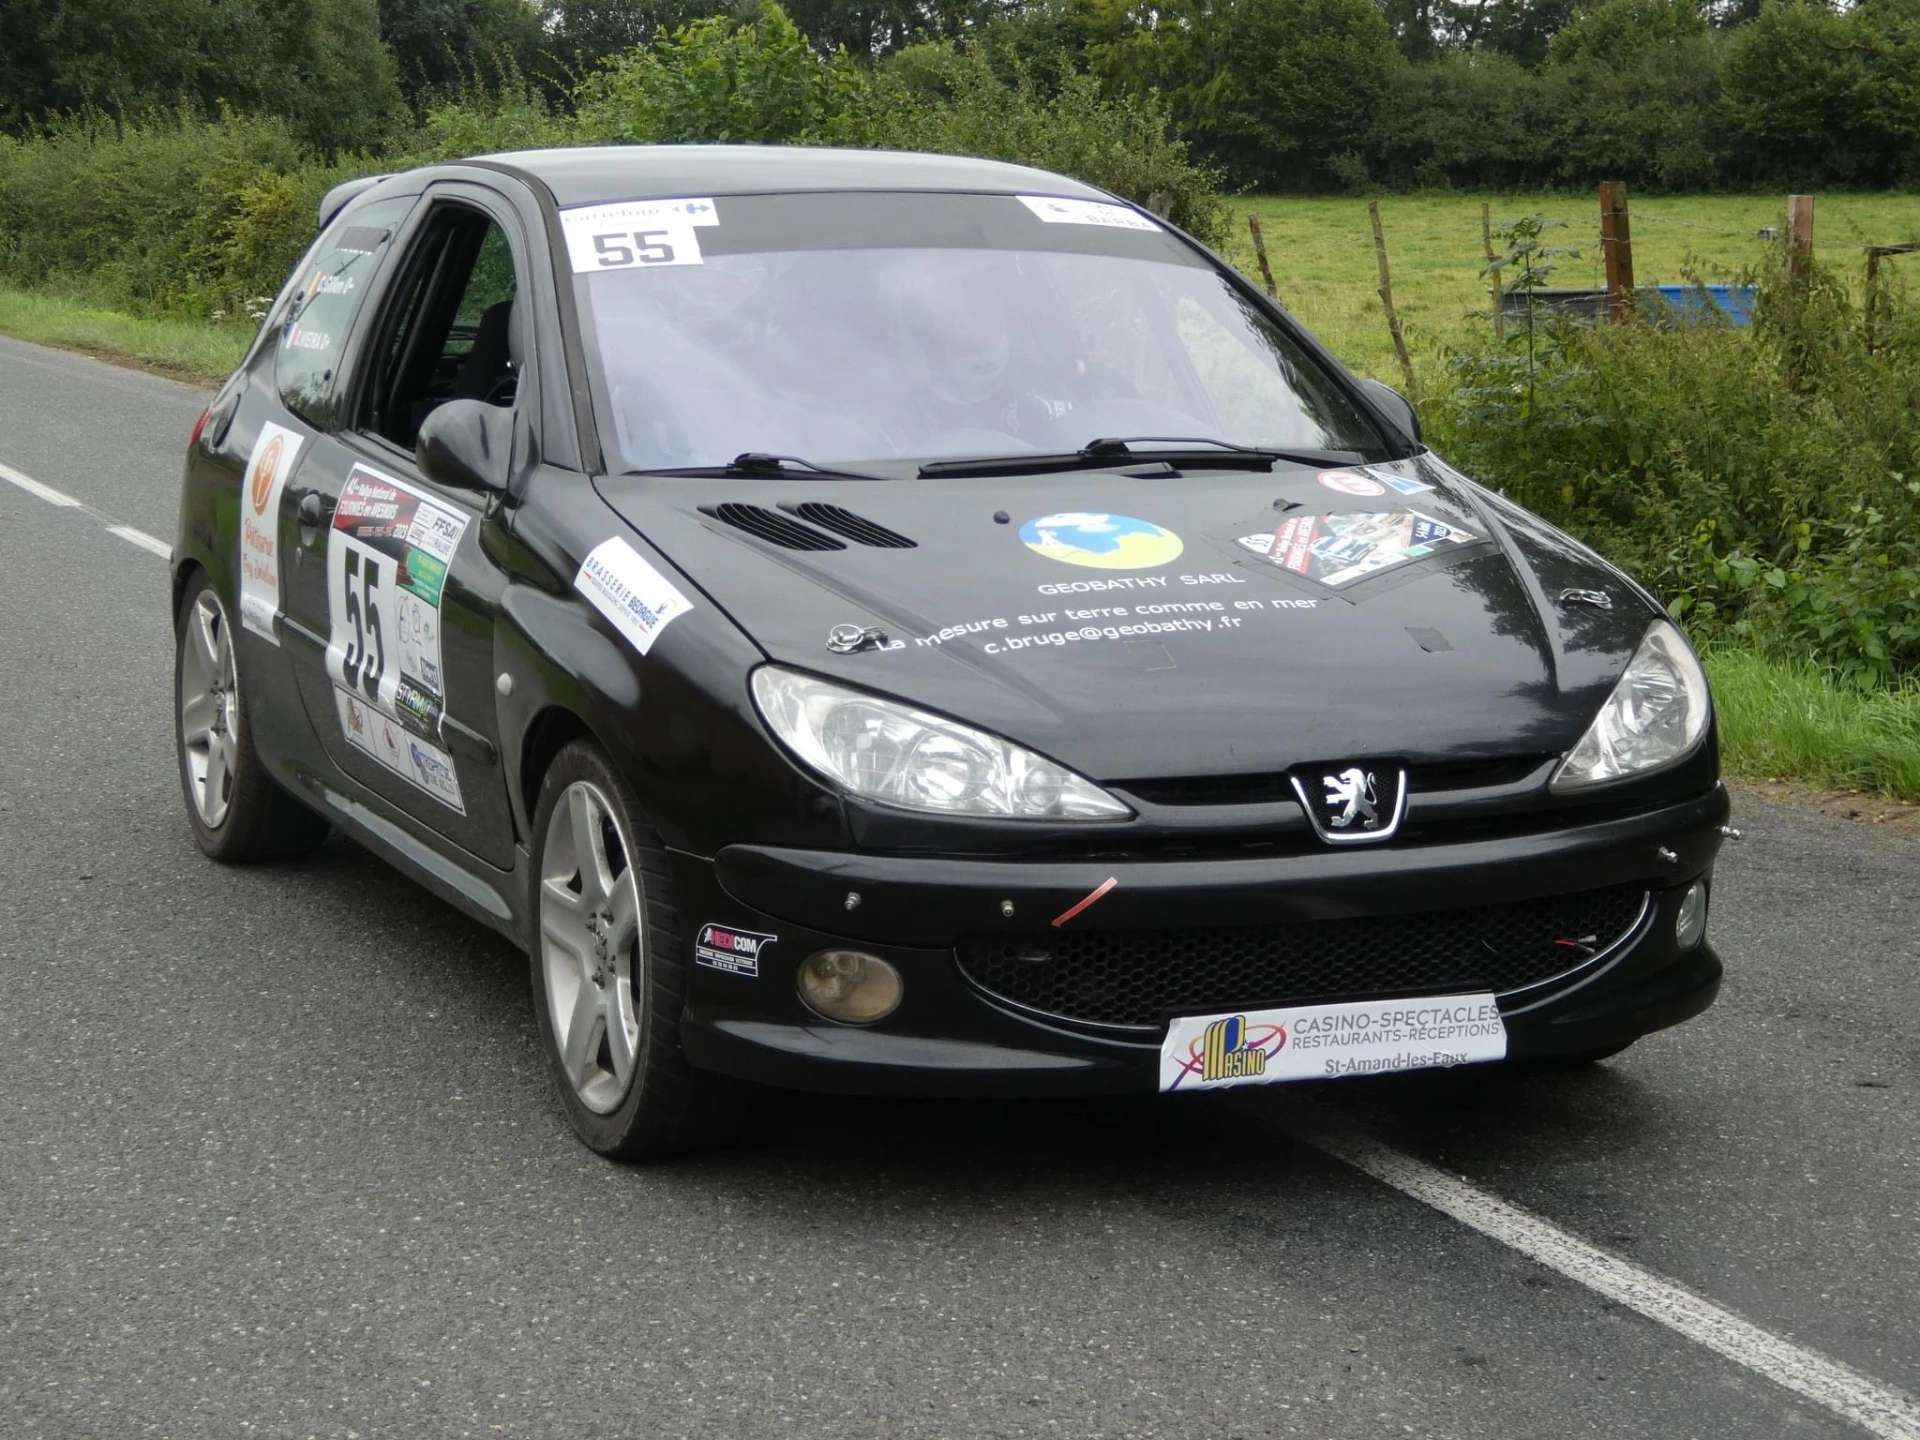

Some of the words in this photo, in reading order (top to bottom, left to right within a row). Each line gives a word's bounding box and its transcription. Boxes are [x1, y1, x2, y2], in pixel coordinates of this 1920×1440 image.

[592, 229, 676, 267] 55
[586, 556, 631, 602] BRASSERIE
[628, 596, 659, 629] BEDAGUE
[1037, 575, 1168, 596] GEOBATHY
[1179, 572, 1246, 586] SARL
[343, 546, 385, 704] 55
[914, 617, 1009, 648] mesure
[1017, 610, 1057, 626] sur
[1064, 606, 1129, 621] terre
[1135, 599, 1225, 616] comme
[1234, 599, 1264, 611] en
[1272, 598, 1319, 610] mer
[984, 615, 1243, 655] c.bruge@geobathy.fr
[1292, 1021, 1501, 1051] RESTAURANTS-RÉCEPTIONS
[1293, 1004, 1502, 1036] CASINO-SPECTACLES
[1202, 1014, 1267, 1082] PASINO
[1324, 1051, 1469, 1075] St-Amand-les-Eaux
